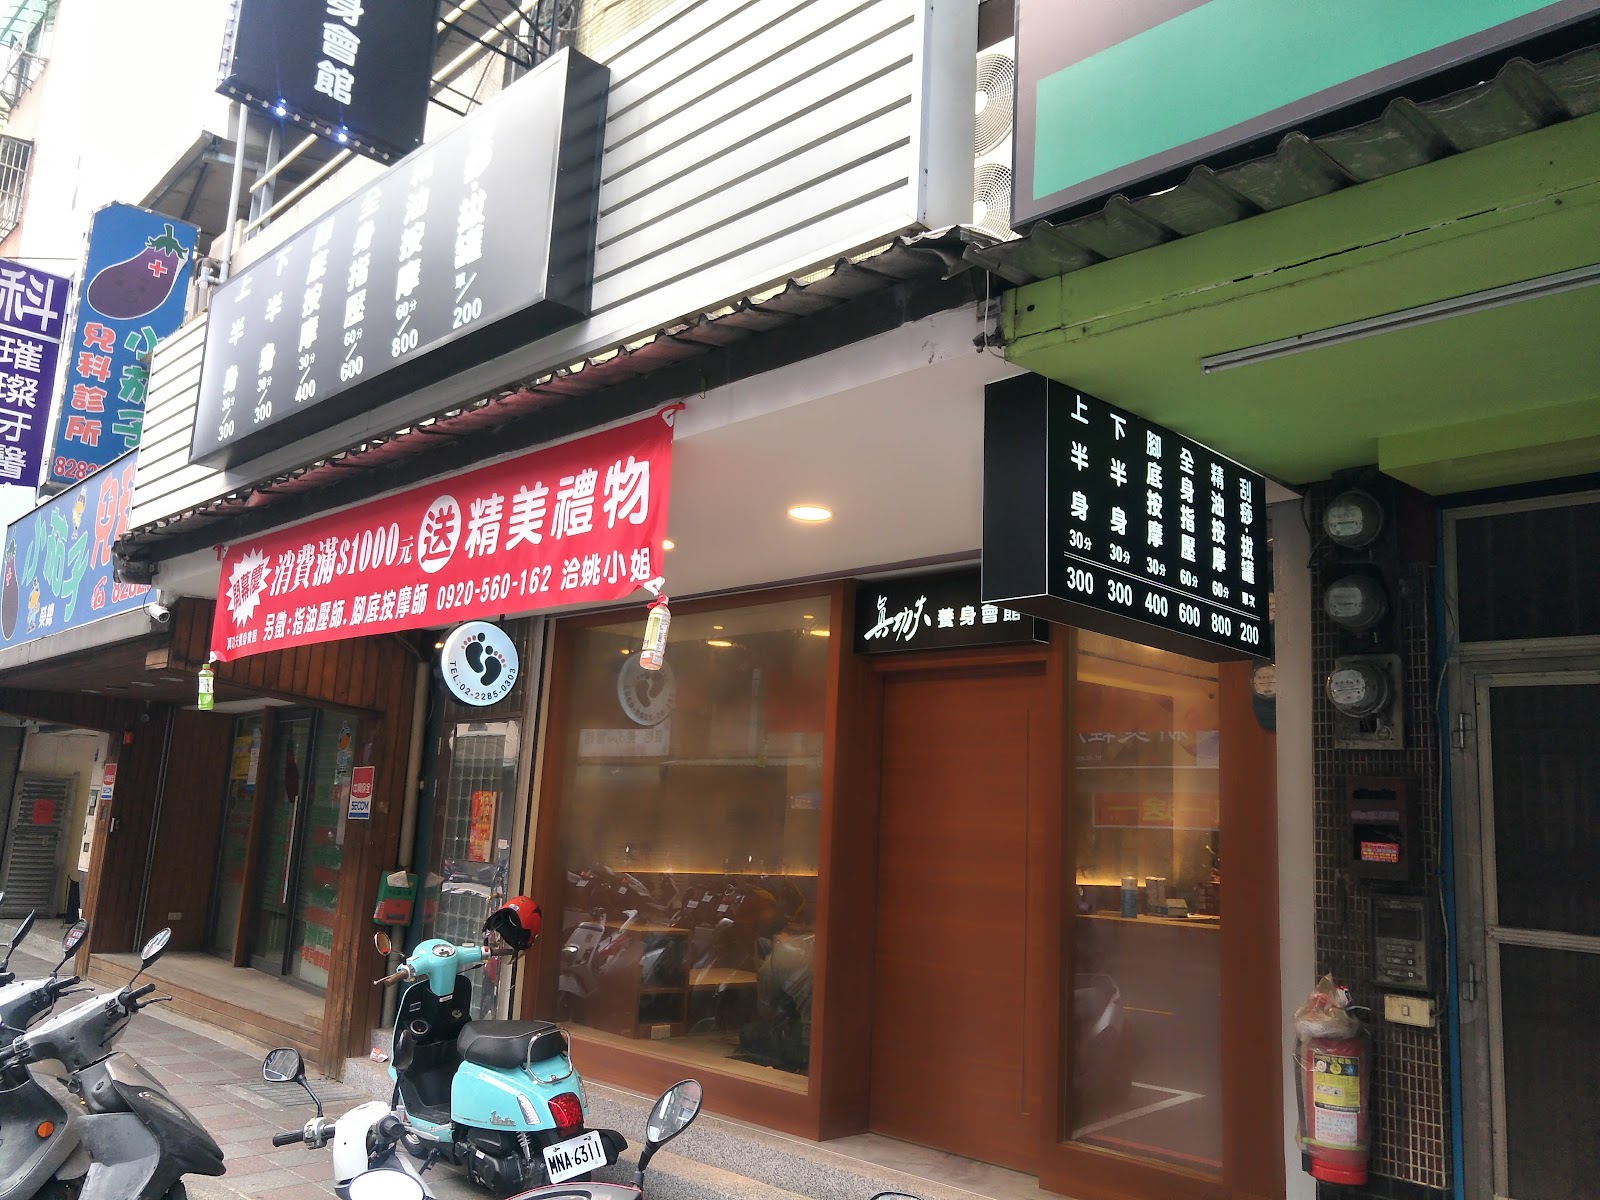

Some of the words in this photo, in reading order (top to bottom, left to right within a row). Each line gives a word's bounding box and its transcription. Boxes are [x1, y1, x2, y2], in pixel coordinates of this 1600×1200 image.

[0, 268, 59, 332] 科
[396, 298, 418, 321] 60分
[452, 297, 483, 329] 200
[343, 327, 364, 348] 60分
[391, 328, 418, 358] 800
[298, 352, 315, 371] 30分
[340, 354, 364, 382] 600
[295, 378, 316, 404] 400
[253, 400, 272, 424] 300
[217, 421, 235, 442] 300
[54, 456, 103, 481] 8282
[1070, 394, 1089, 522] 上半身
[1109, 413, 1128, 536] 下半身
[1146, 430, 1164, 548] 腳底按摩
[1179, 447, 1196, 563] 全身指壓
[1210, 462, 1226, 573] 精油按摩
[269, 522, 414, 597] 消費滿$1000元
[422, 504, 456, 562] 送
[464, 455, 651, 559] 精美禮物
[1069, 528, 1092, 551] 30分
[1109, 542, 1131, 565] 30分
[436, 564, 553, 611] 0920-560-162
[560, 546, 651, 591] 洽姚小姐
[1146, 556, 1166, 577] 30分
[1179, 568, 1198, 588] 60分
[1067, 566, 1094, 594] 300
[1107, 579, 1133, 606] 300
[1212, 580, 1229, 599] 60分
[1144, 591, 1168, 617] 400
[1178, 602, 1200, 627] 600
[1211, 612, 1231, 637] 800
[1239, 622, 1259, 645] 200
[350, 800, 370, 811] SECOM
